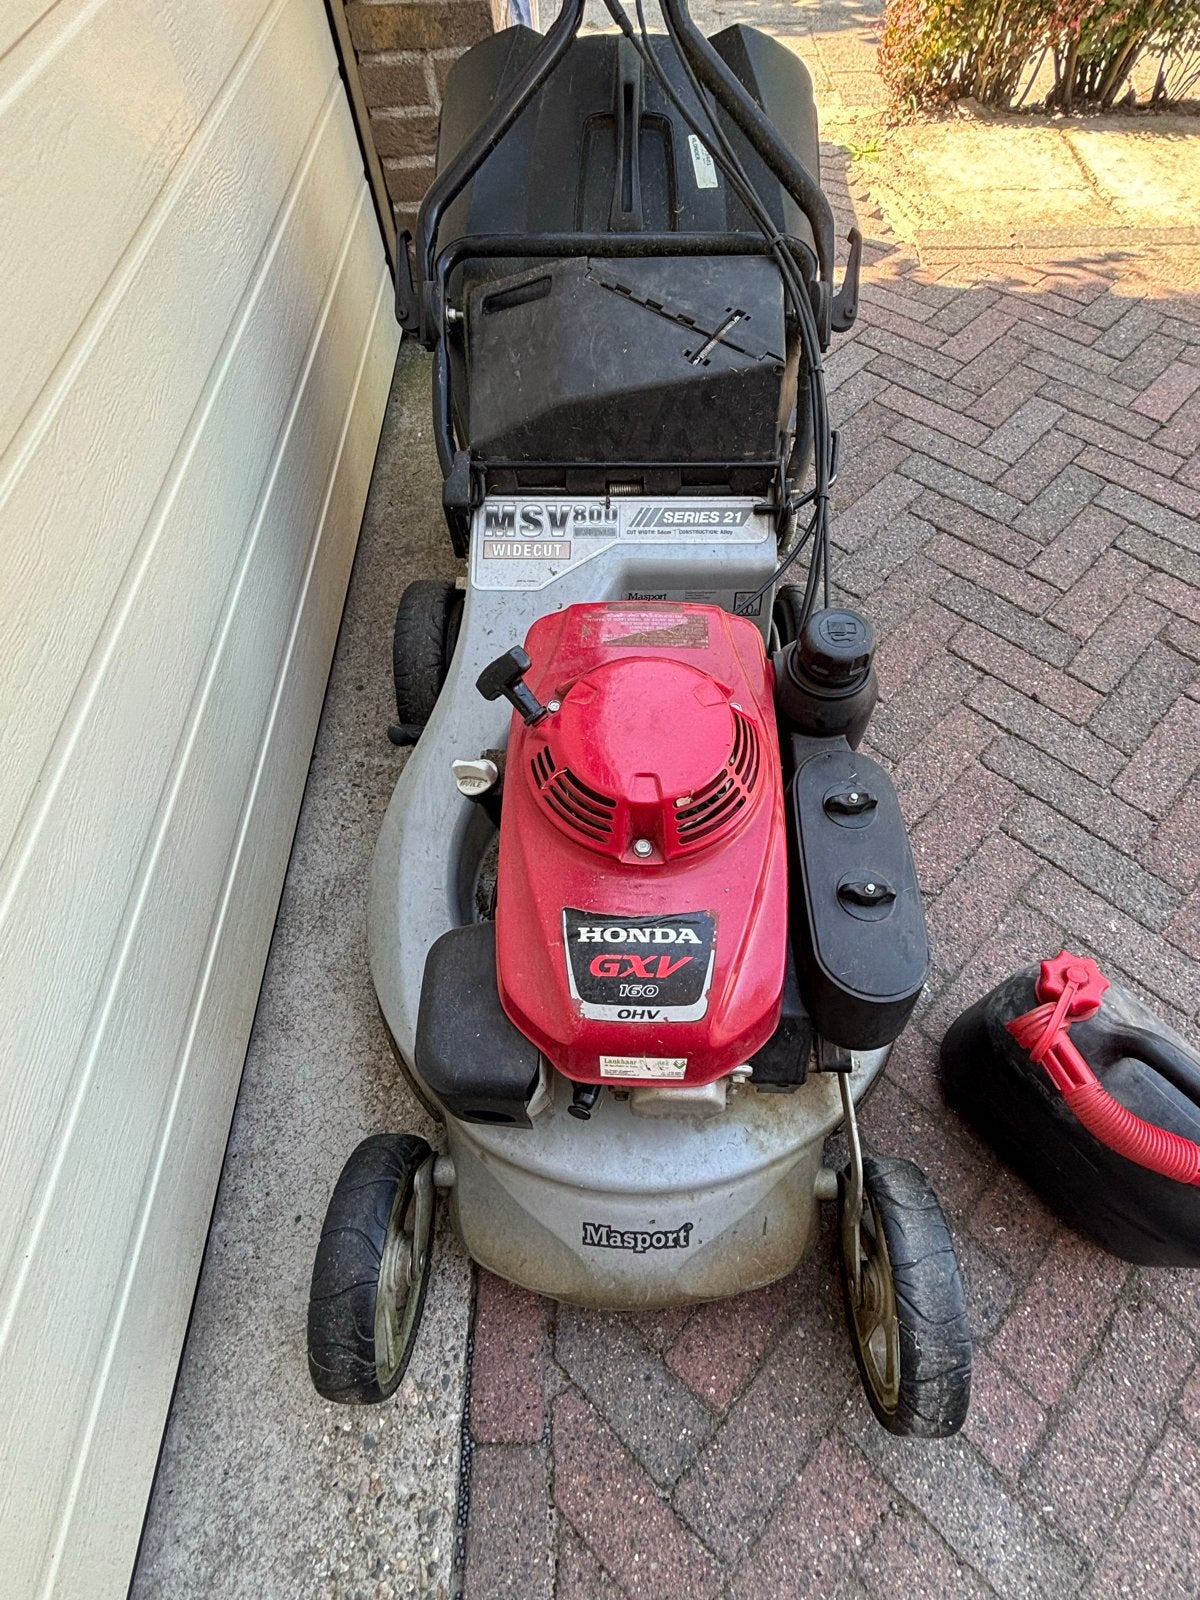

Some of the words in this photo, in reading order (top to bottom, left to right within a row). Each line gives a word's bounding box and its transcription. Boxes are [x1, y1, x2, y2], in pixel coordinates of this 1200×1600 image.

[484, 505, 573, 538] MSV
[573, 505, 618, 524] 800
[663, 511, 720, 524] SERIES
[722, 511, 743, 524] 21
[492, 543, 563, 557] WIDECUT
[627, 592, 668, 602] Masport
[577, 927, 703, 944] HONDA
[589, 954, 694, 978] GXV
[619, 984, 660, 998] 160
[617, 1009, 661, 1020] OHV
[582, 1222, 690, 1253] Masport
